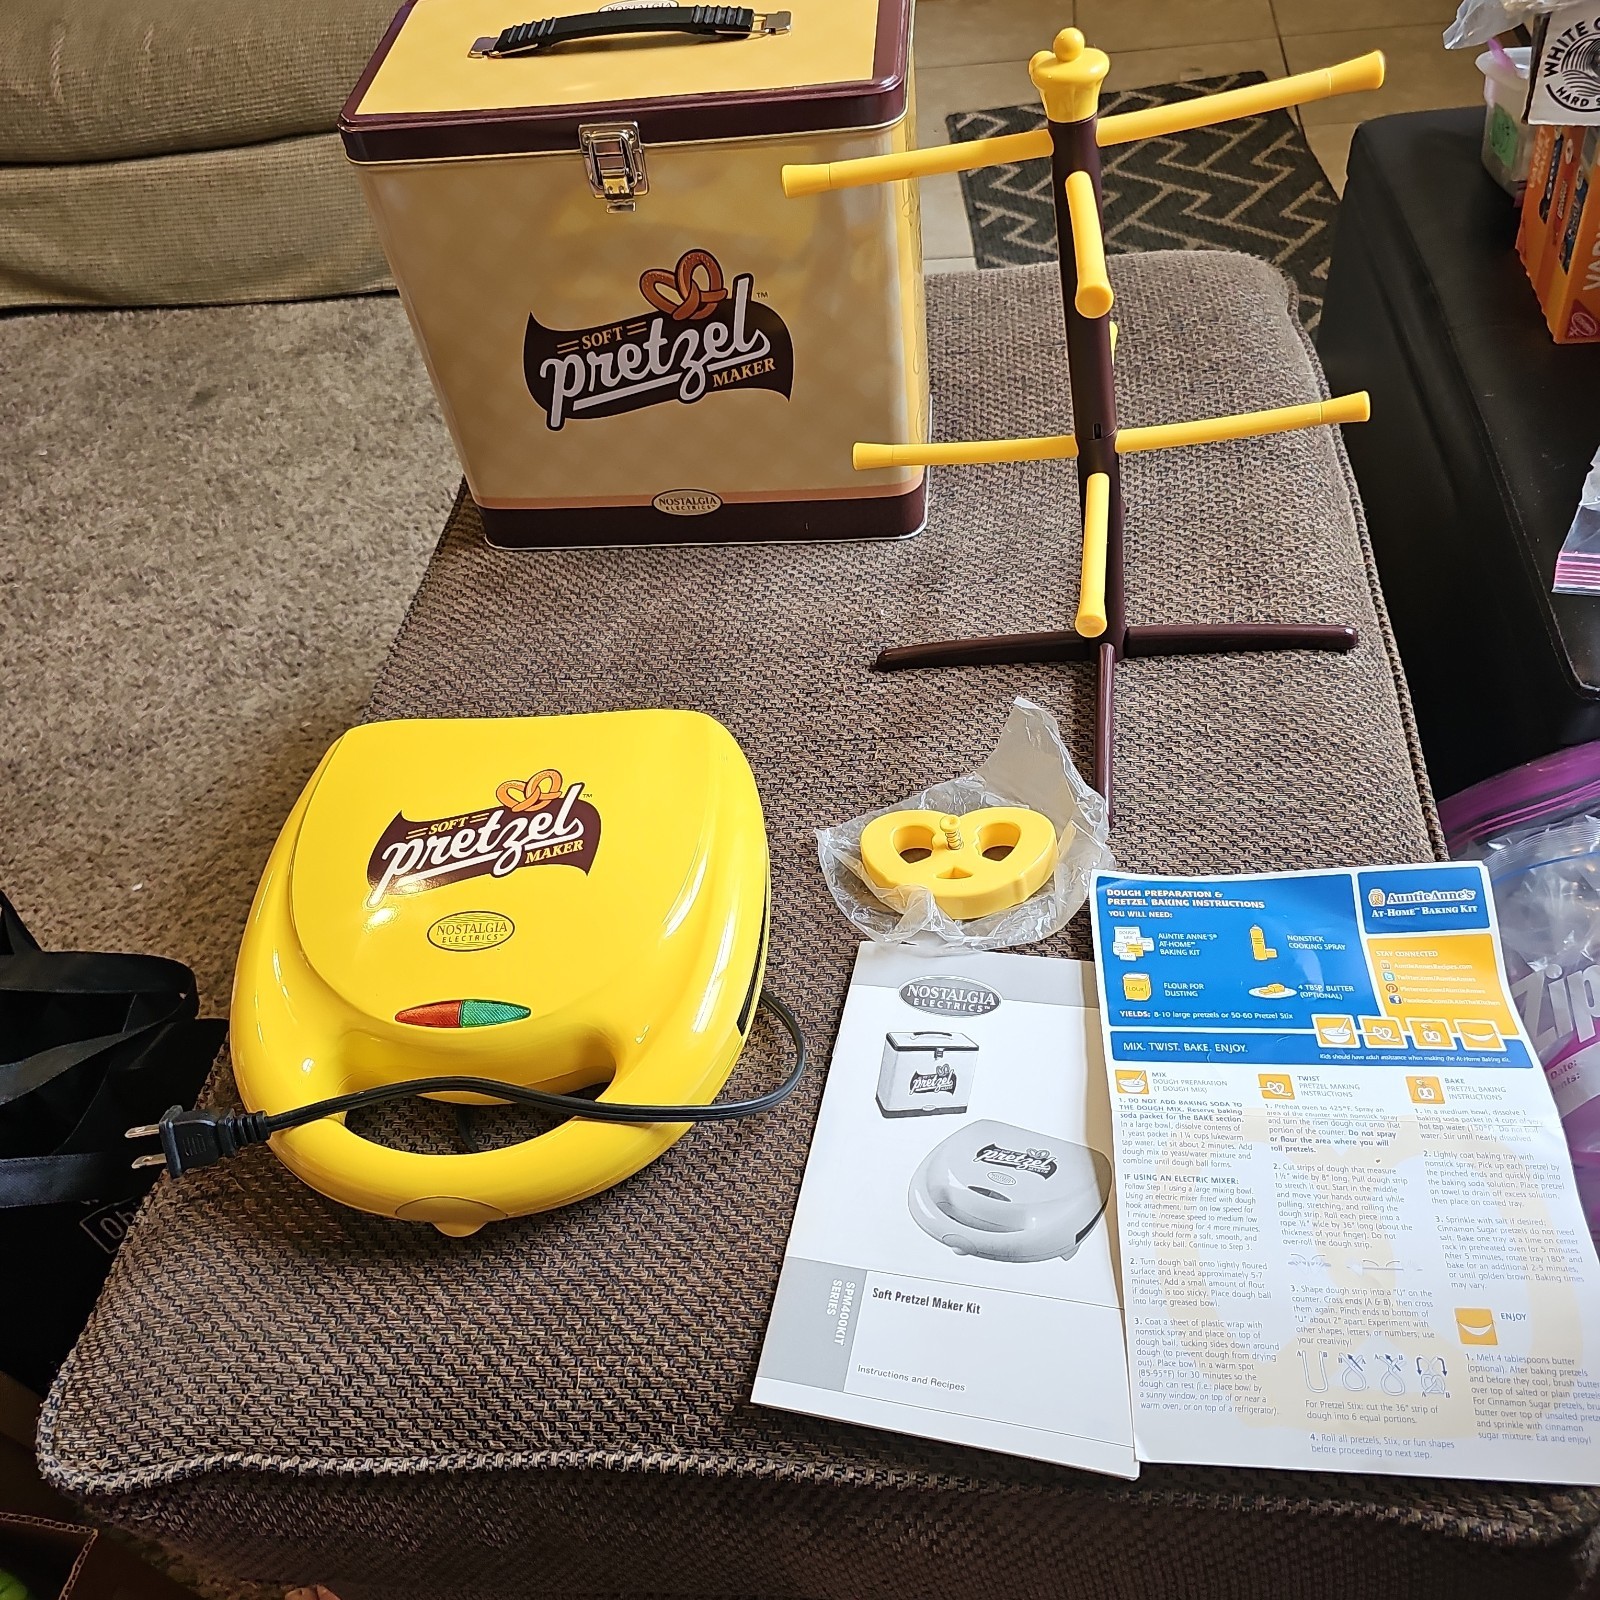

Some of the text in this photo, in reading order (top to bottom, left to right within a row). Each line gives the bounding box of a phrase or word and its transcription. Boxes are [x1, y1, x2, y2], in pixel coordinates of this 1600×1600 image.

[1544, 21, 1588, 78] WHITE
[1556, 87, 1589, 106] HARD
[582, 327, 623, 349] SOFT
[540, 277, 771, 428] pretzel
[712, 358, 776, 387] MAKER
[659, 497, 717, 505] NOSTALGIA
[428, 816, 469, 836] SOFT
[367, 783, 584, 908] pretzel
[525, 839, 584, 863] MAKER
[1107, 889, 1141, 897] DOUGH
[1107, 898, 1148, 906] PRETZEL
[1193, 899, 1265, 908] INSTRUCTIONS
[437, 922, 507, 935] NOSTALGIA
[907, 985, 996, 1005] NOSTALGIA
[1300, 992, 1342, 1000] (OPTIONAL)
[1148, 1043, 1180, 1051] TWIST.
[1215, 1044, 1248, 1053] ENJOY.
[909, 1069, 954, 1095] pretzel
[973, 1150, 1056, 1170] pretzel
[1433, 1151, 1457, 1159] Lightly
[1477, 1153, 1500, 1161] baking
[827, 1279, 842, 1315] SERIES
[873, 1288, 981, 1314] Soft Pretzel Maker Kit
[834, 1281, 855, 1346] SPM400KIT
[1501, 1313, 1526, 1321] ENJOY
[1201, 1320, 1224, 1328] plastic
[858, 1365, 965, 1391] Instructions and Recipes
[1320, 1401, 1344, 1409] Pretzel
[1367, 1403, 1377, 1411] cut
[1411, 1406, 1428, 1414] strip
[1477, 1420, 1491, 1428] and
[1494, 1421, 1523, 1429] sprinkle
[1545, 1424, 1583, 1432] cinnamon
[1479, 1432, 1498, 1440] sugar
[1568, 1435, 1591, 1444] enjoy!
[1312, 1445, 1432, 1459] before proceeding to next step.
